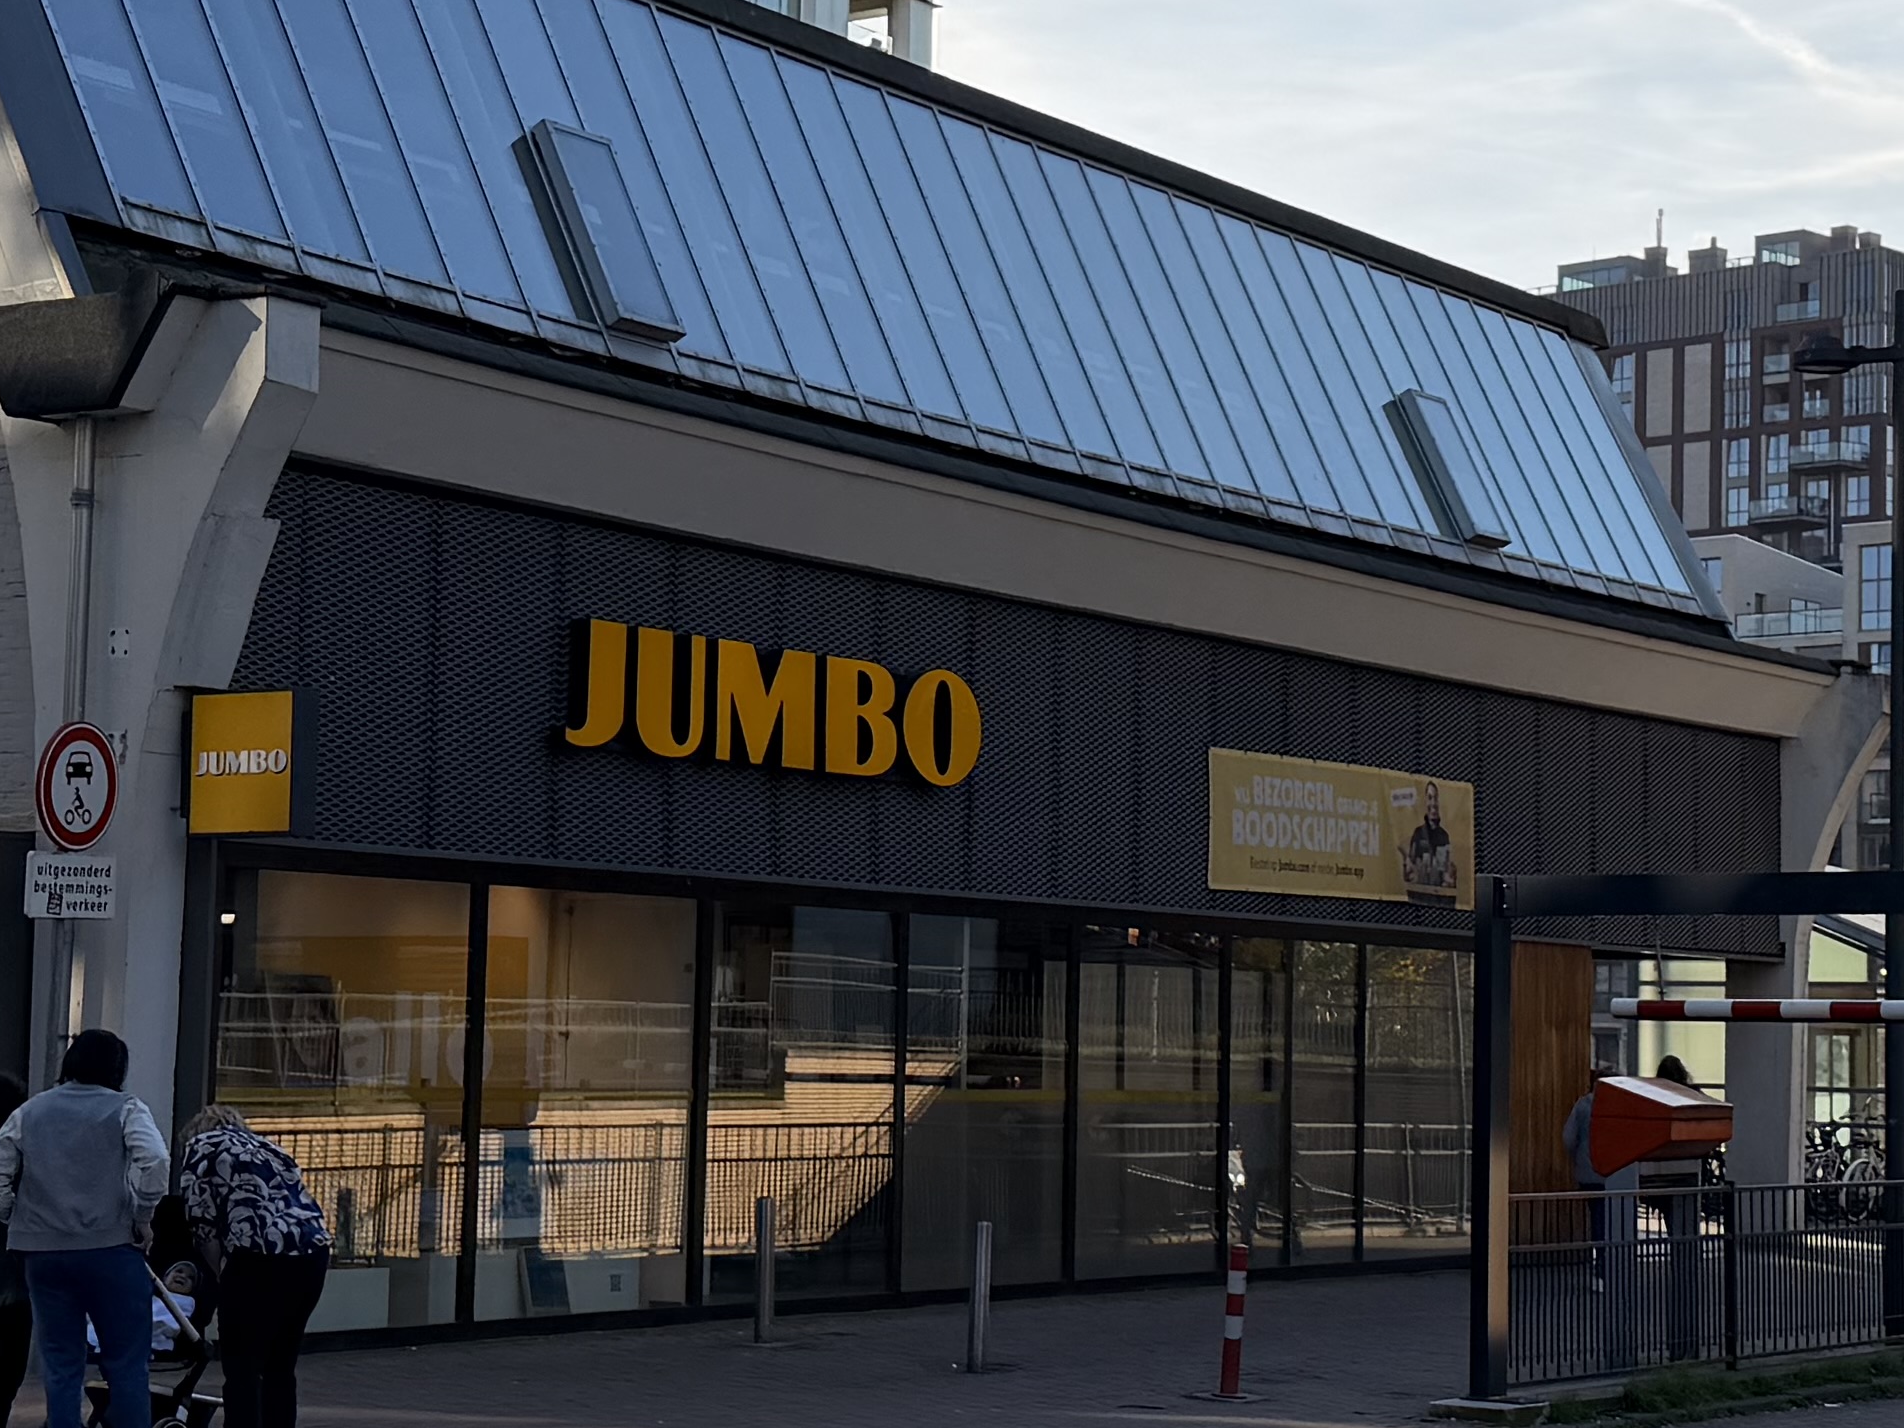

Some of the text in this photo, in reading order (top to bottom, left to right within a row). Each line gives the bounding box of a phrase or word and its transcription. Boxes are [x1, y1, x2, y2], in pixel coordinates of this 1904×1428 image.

[565, 618, 982, 787] JUMBO
[195, 748, 288, 777] JUMBO
[1253, 775, 1334, 812] BEZORGEN
[1232, 808, 1380, 856] BOODSCHAPPEN
[37, 862, 112, 880] uitgezonderd
[33, 880, 113, 898] bestemmings-
[65, 898, 108, 912] verkeer
